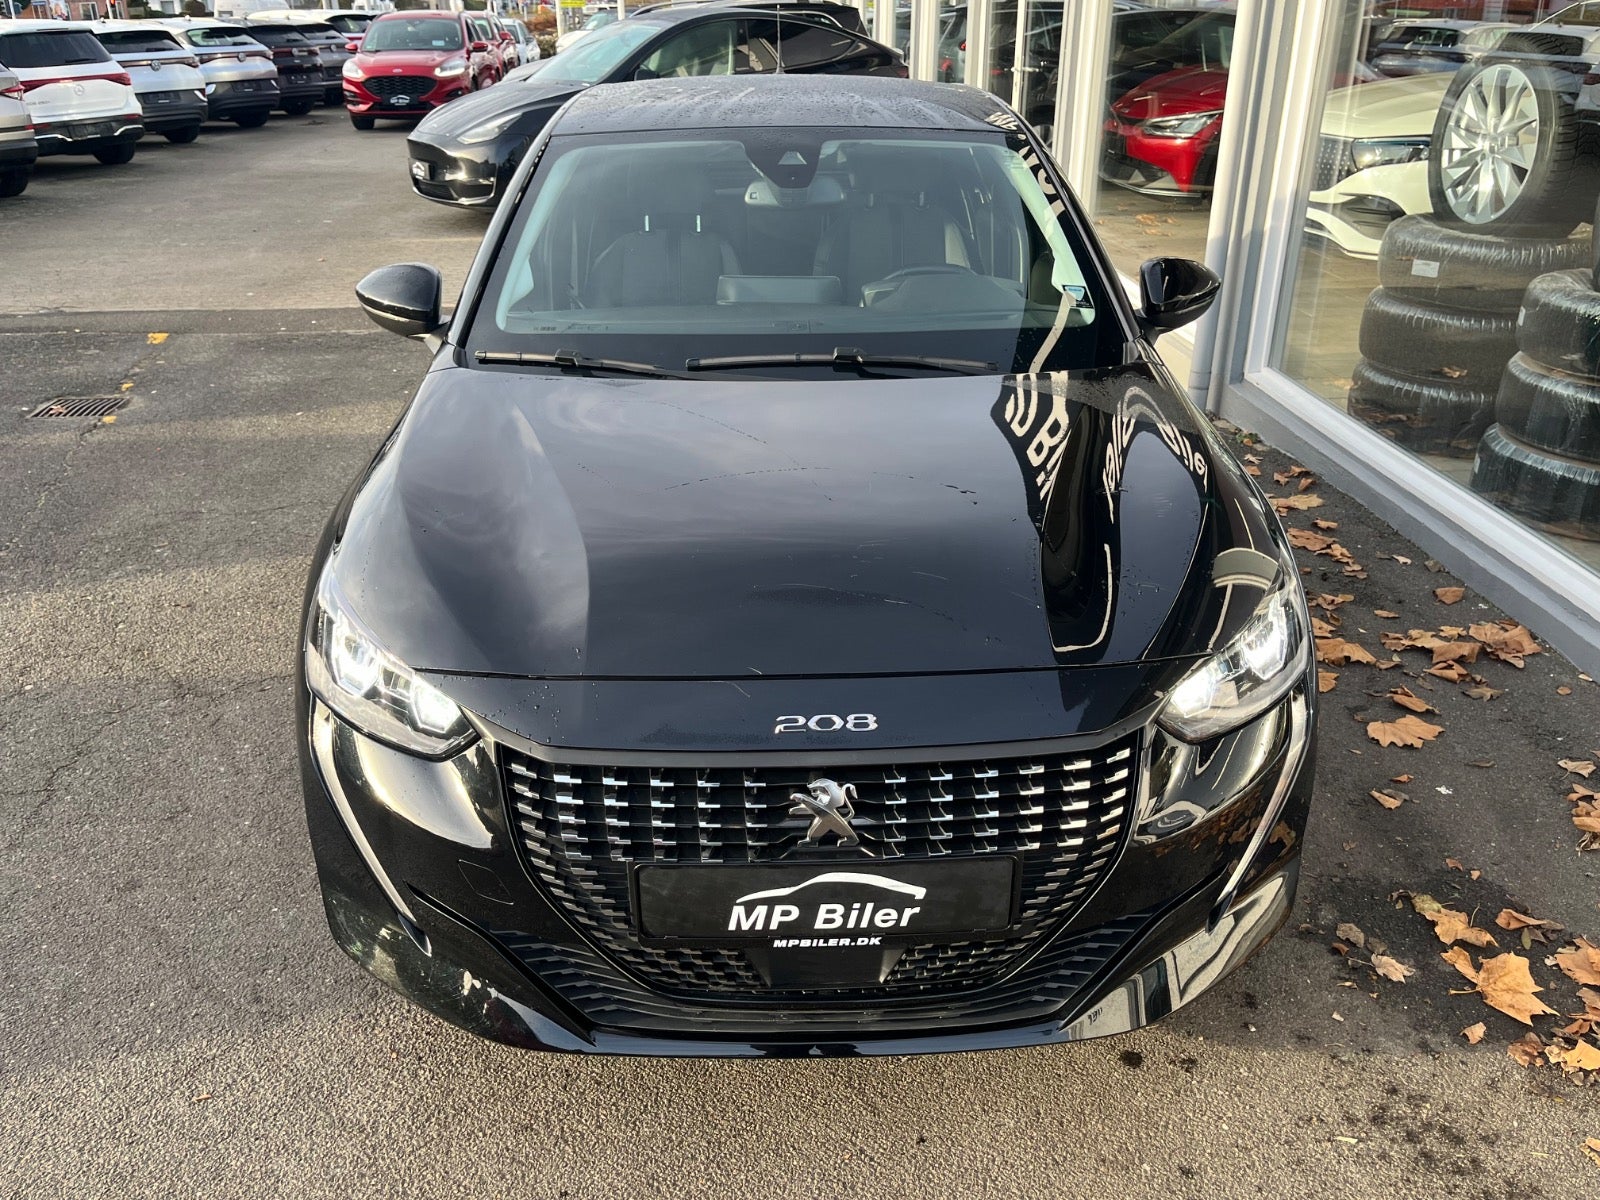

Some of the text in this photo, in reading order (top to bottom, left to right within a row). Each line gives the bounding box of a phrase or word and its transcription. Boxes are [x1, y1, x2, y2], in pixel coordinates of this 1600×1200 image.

[774, 713, 879, 734] 208
[728, 902, 921, 931] MP Biler
[773, 936, 882, 948] MPBILER.DK
